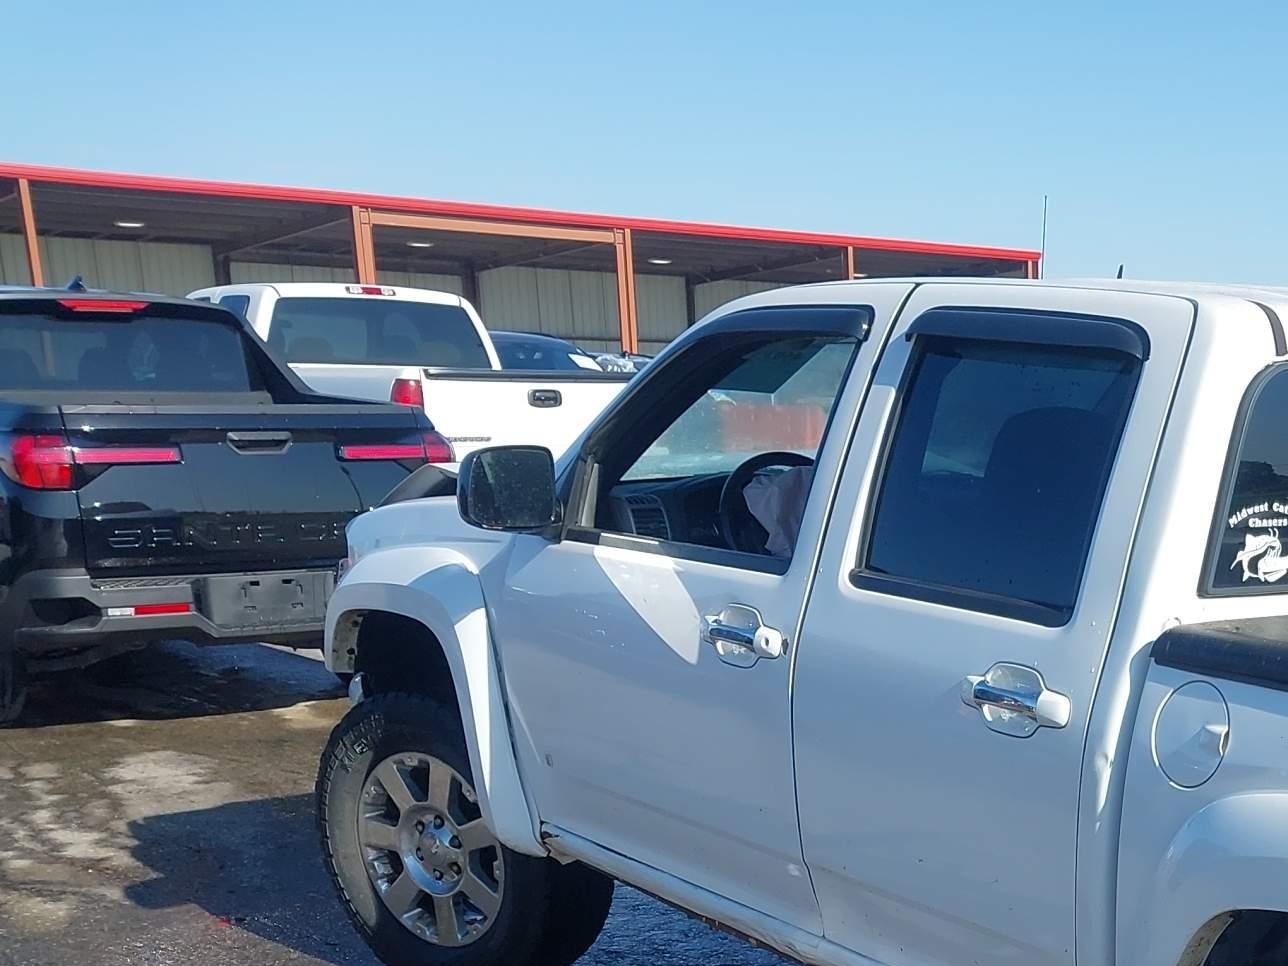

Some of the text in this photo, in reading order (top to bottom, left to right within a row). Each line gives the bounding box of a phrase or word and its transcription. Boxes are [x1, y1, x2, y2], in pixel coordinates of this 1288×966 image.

[1228, 502, 1269, 529] Midwest
[1248, 517, 1288, 528] Chasers
[107, 522, 286, 549] SANTA
